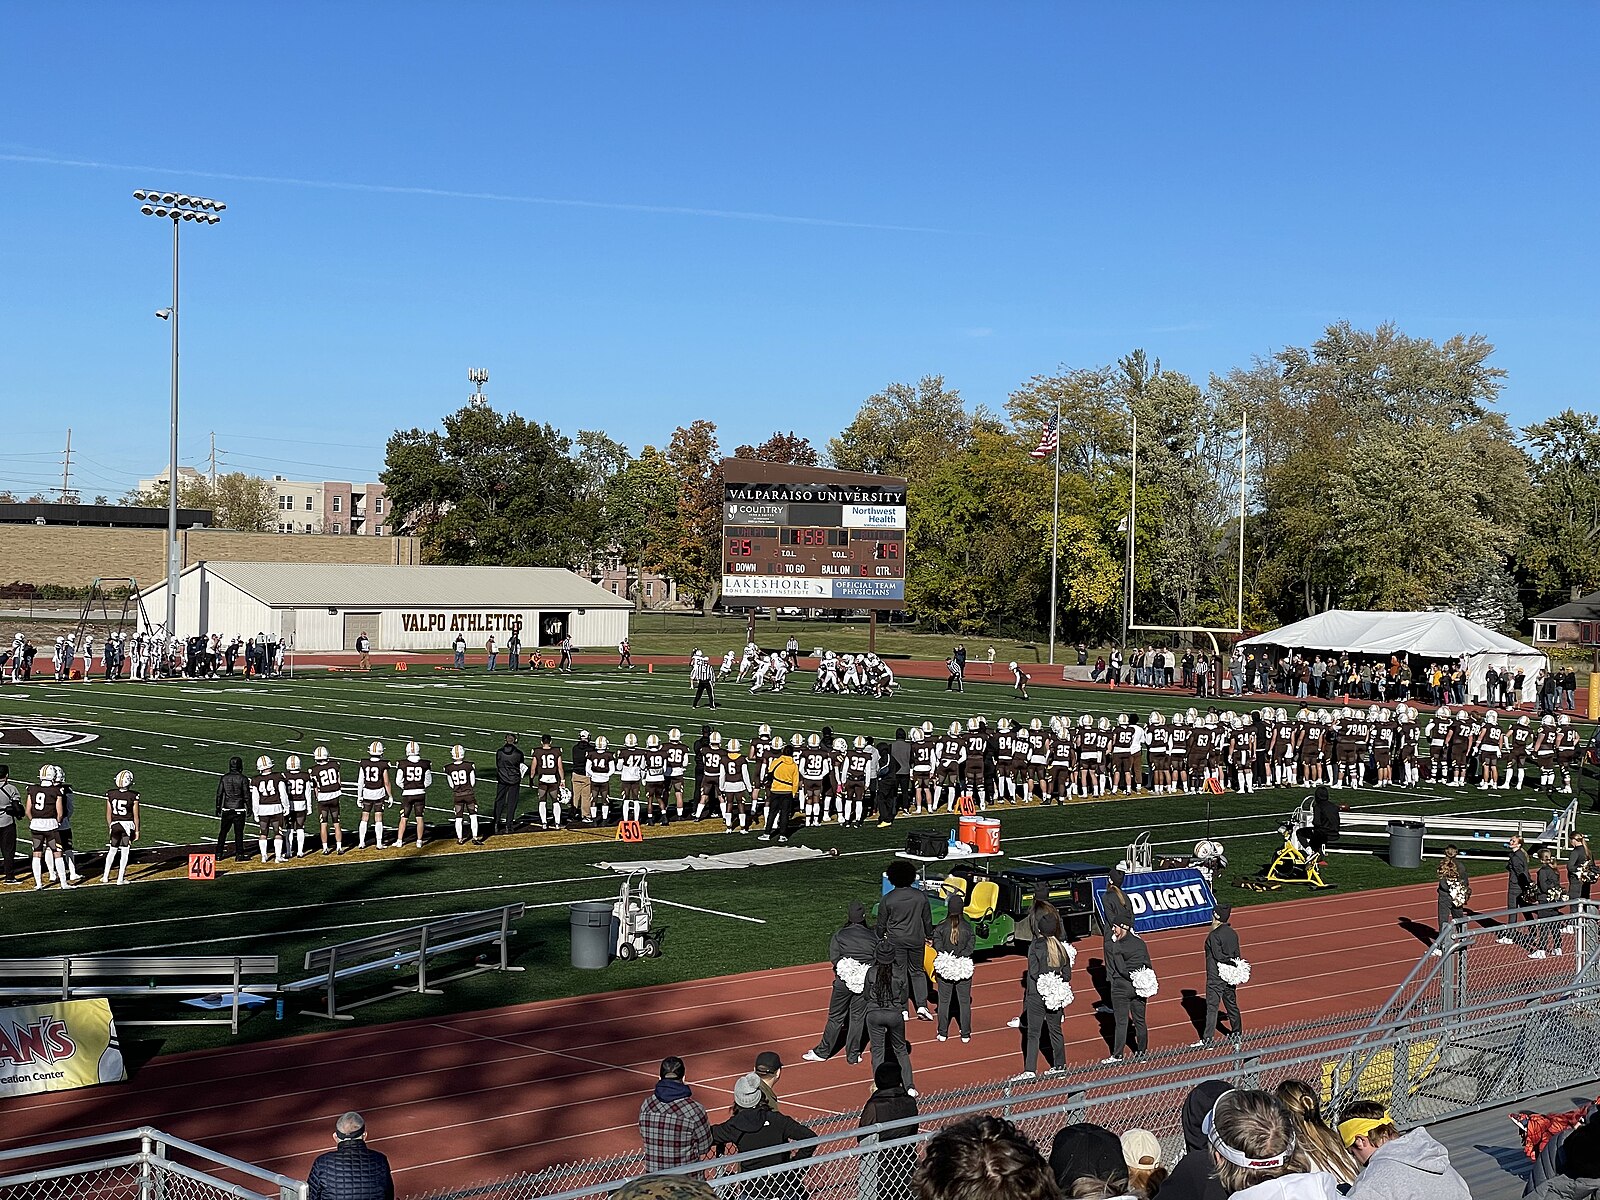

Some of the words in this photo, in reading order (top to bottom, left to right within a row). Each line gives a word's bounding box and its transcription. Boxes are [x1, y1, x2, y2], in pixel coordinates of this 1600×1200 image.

[729, 489, 813, 501] VALPARAISO
[818, 491, 902, 502] UNIVERSITY
[852, 506, 896, 515] Northwest
[868, 515, 896, 523] Health
[730, 539, 752, 556] 25
[883, 544, 898, 558] 19
[735, 563, 757, 572] DOWN
[784, 564, 794, 573] TO
[795, 564, 806, 574] GO
[821, 565, 839, 575] BALL
[839, 565, 850, 575] ON
[875, 566, 892, 576] QTR.
[725, 578, 810, 590] LAKESHORE
[836, 581, 873, 589] OFFICIAL
[874, 582, 897, 590] TEAM
[401, 613, 446, 632] VALPO
[449, 613, 523, 632] ATHLETICS
[1119, 731, 1132, 743] 85
[1154, 728, 1166, 741] 23
[1173, 729, 1186, 742] 50
[1279, 726, 1292, 739] 45
[1308, 728, 1321, 740] 99
[1458, 724, 1470, 737] 72
[1489, 727, 1502, 740] 89
[1516, 729, 1528, 742] 87
[969, 737, 983, 751] 70
[999, 736, 1012, 750] 84
[1083, 732, 1097, 745] 27
[1096, 735, 1108, 749] 18
[1197, 734, 1209, 747] 63
[1237, 732, 1249, 746] 34
[918, 747, 929, 761] 31
[945, 741, 959, 755] 12
[1015, 740, 1029, 754] 88
[1056, 744, 1071, 758] 25
[541, 754, 555, 769] 16
[626, 754, 641, 767] 47
[649, 755, 663, 767] 19
[667, 748, 683, 763] 36
[705, 753, 720, 767] 39
[807, 754, 822, 769] 38
[593, 758, 606, 768] 14
[727, 761, 736, 775] 6
[850, 755, 866, 771] 32
[319, 767, 337, 786] 20
[365, 766, 379, 782] 13
[406, 766, 422, 782] 59
[451, 769, 467, 786] 99
[259, 779, 276, 796] 44
[34, 792, 46, 811] 9
[111, 798, 128, 816] 15
[963, 798, 974, 814] 40
[623, 821, 639, 840] 50
[190, 855, 213, 878] 40
[1145, 883, 1208, 912] LIGHT
[0, 1074, 32, 1085] eation
[32, 1070, 65, 1081] Center
